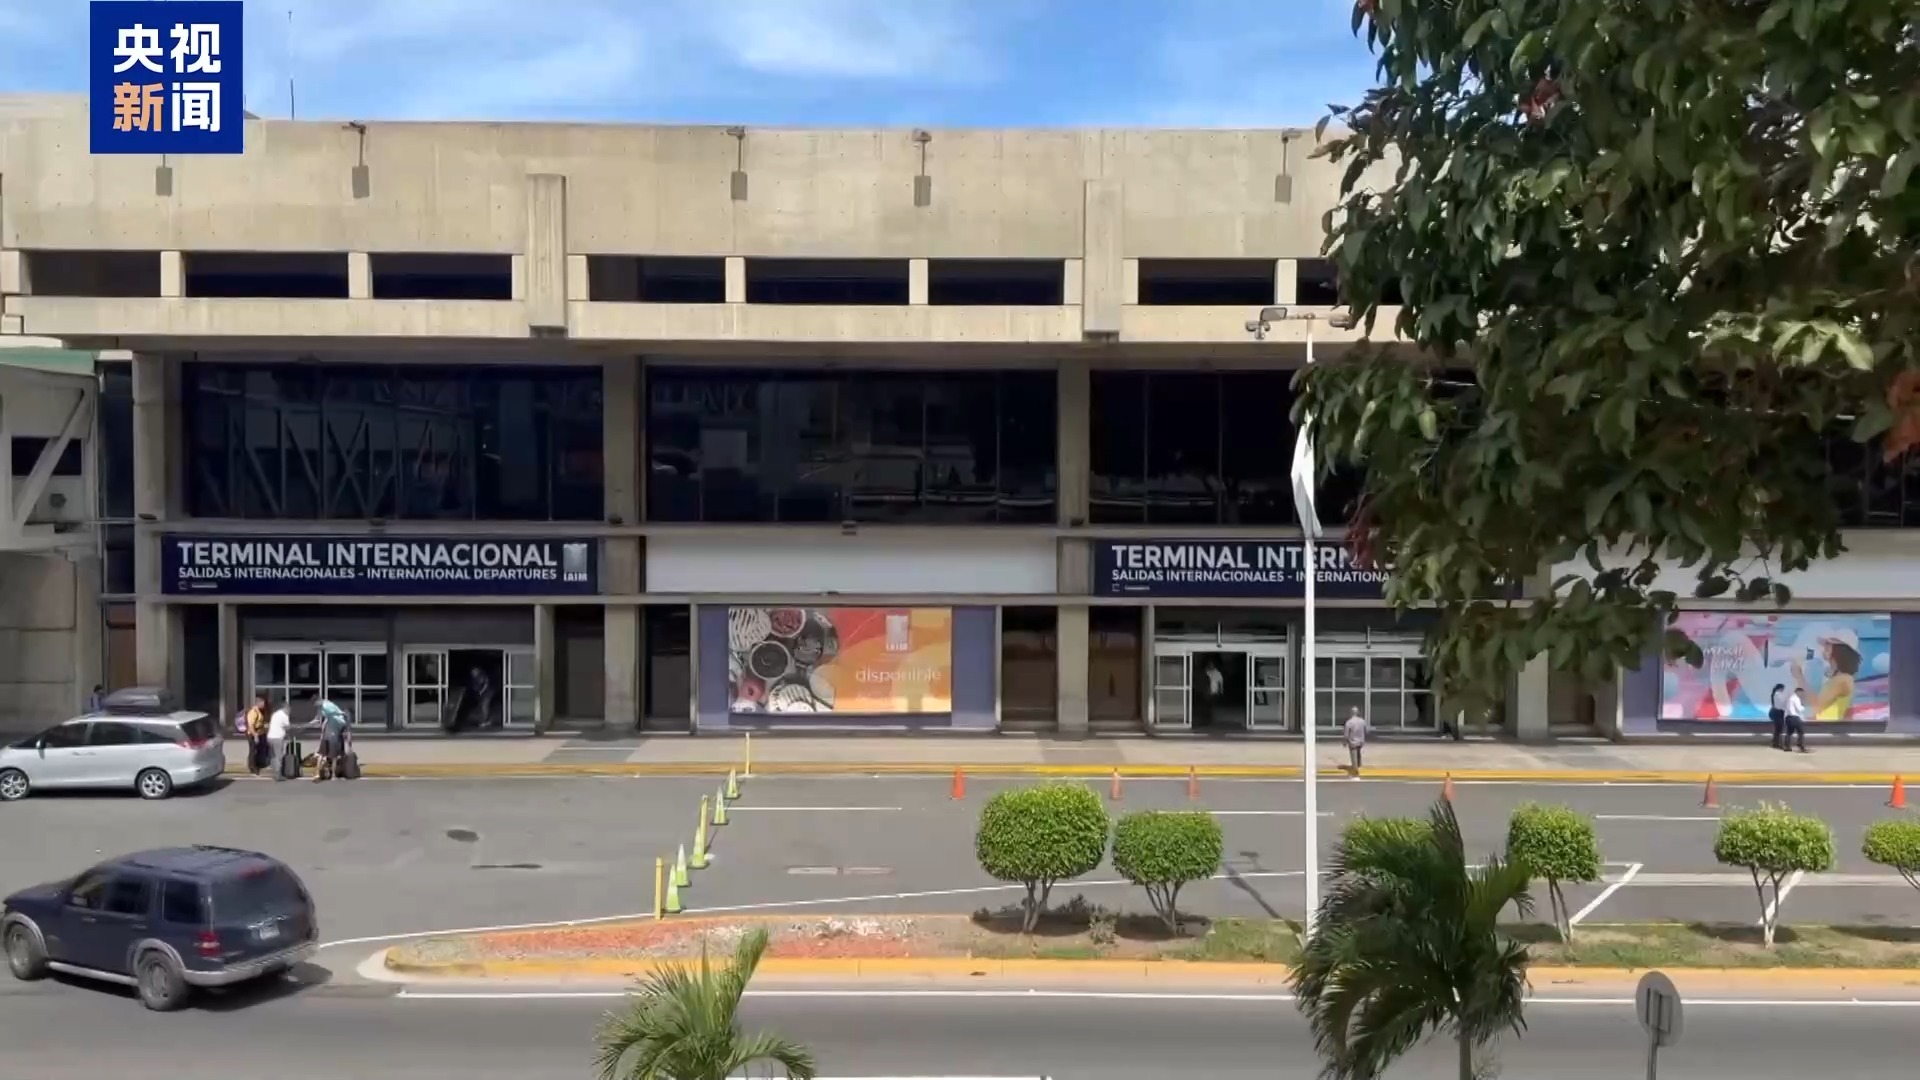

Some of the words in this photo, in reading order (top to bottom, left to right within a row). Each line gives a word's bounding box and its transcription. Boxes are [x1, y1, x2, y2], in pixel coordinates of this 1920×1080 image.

[177, 541, 321, 566] TERMINAL
[327, 543, 558, 566] INTERNACIONAL
[1111, 545, 1250, 568] TERMINAL
[178, 567, 231, 578] SALIDAS
[234, 567, 355, 579] INTERNACIONALES
[367, 568, 471, 580] INTERNATIONAL
[474, 568, 557, 580] DEPARTURES
[1111, 569, 1163, 581] SALIDAS
[1166, 570, 1284, 582] INTERNACIONALES
